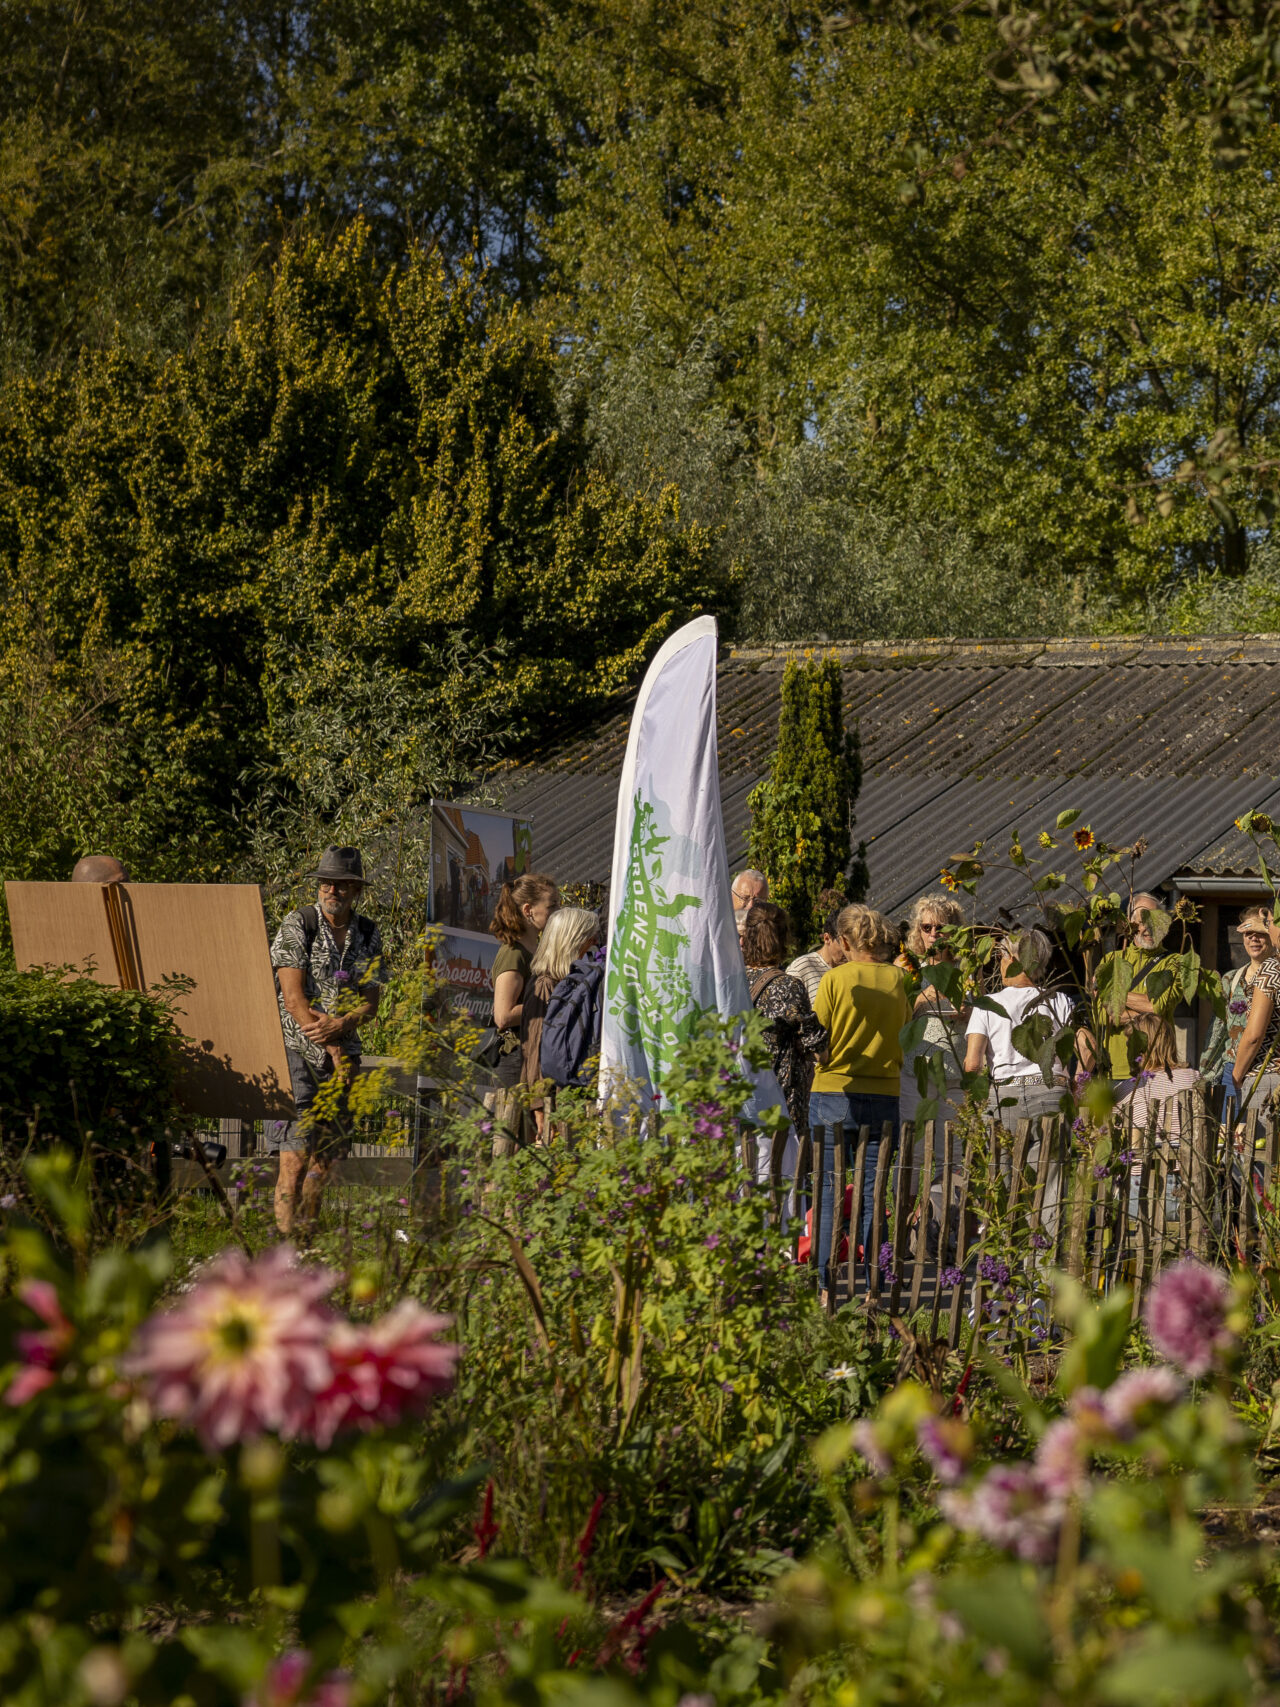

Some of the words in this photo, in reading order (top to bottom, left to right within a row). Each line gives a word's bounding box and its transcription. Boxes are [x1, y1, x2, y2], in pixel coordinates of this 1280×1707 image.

[630, 842, 649, 950] GROENE
[432, 959, 483, 988] Groene
[624, 949, 664, 1025] LOPER
